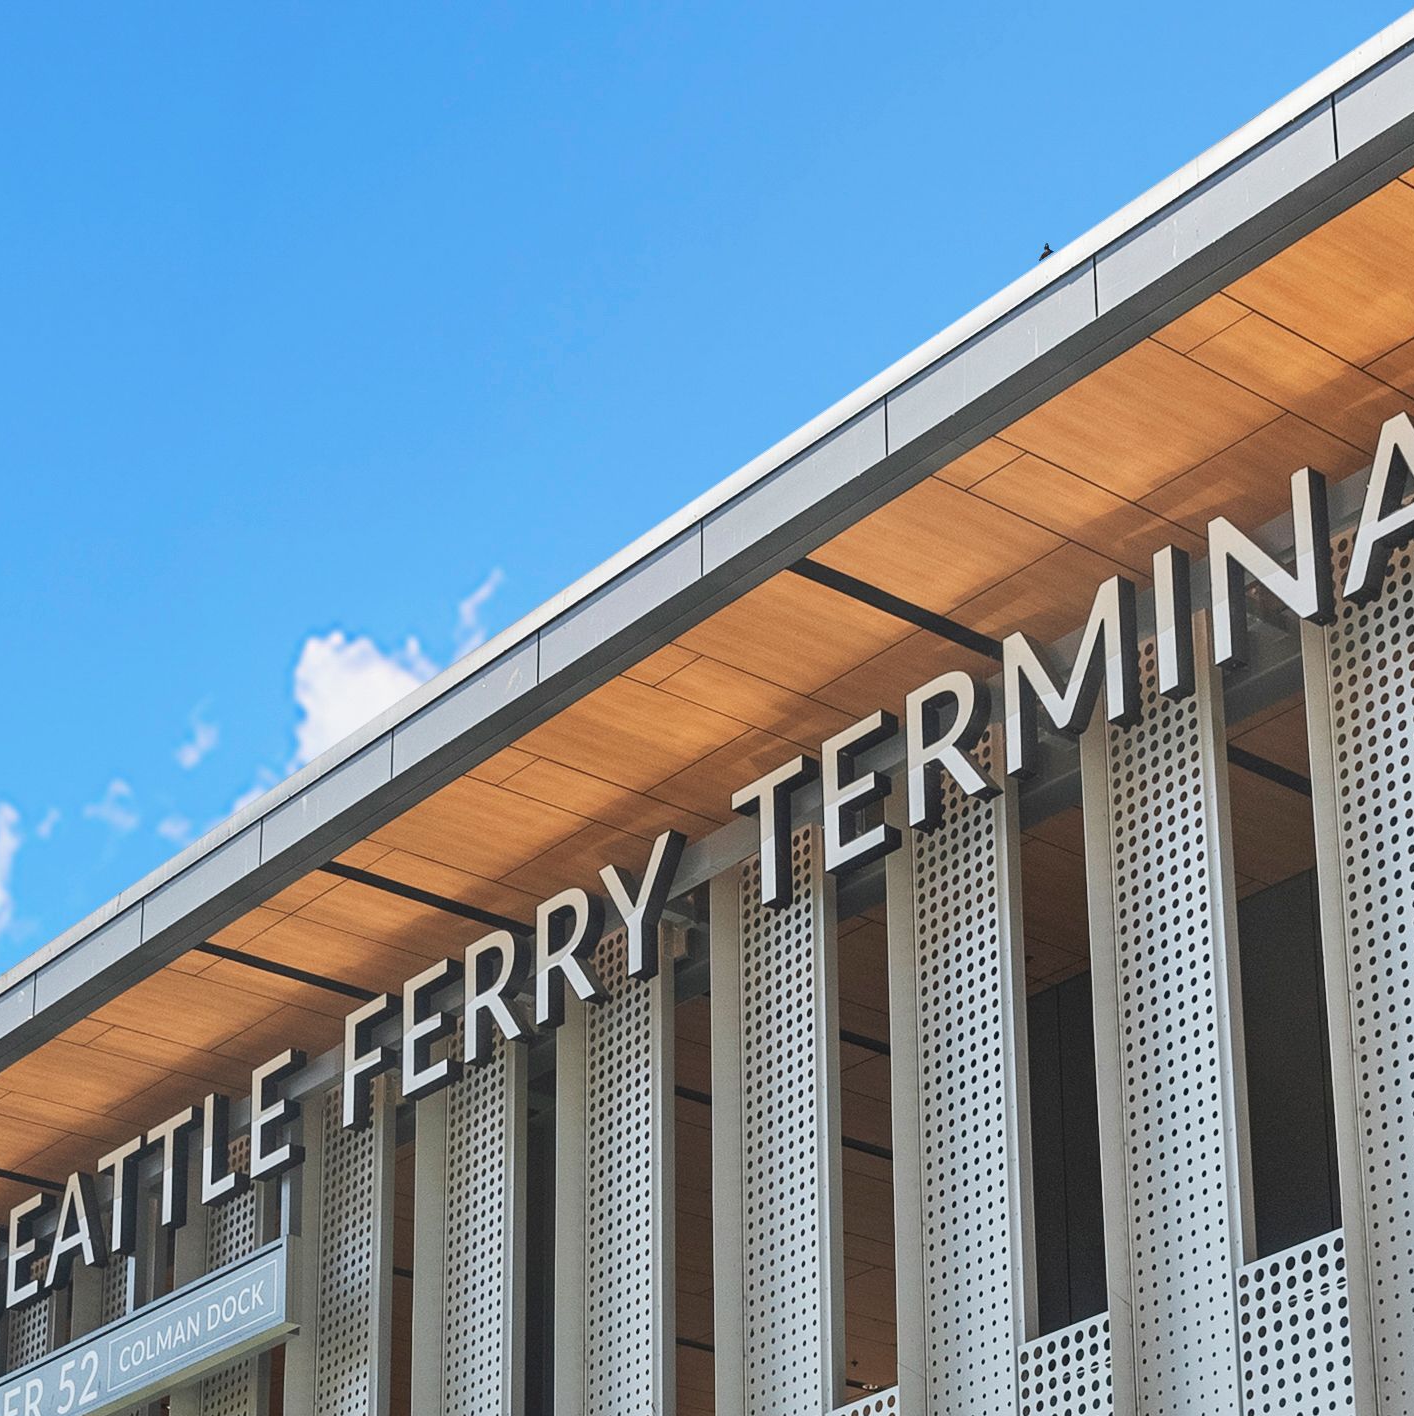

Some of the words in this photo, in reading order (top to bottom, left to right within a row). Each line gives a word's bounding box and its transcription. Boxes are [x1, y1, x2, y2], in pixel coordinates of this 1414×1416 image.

[343, 829, 680, 1130] FERRY
[119, 1311, 200, 1373] COLMAN
[206, 1280, 265, 1332] DOCK
[57, 1350, 99, 1415] 52
